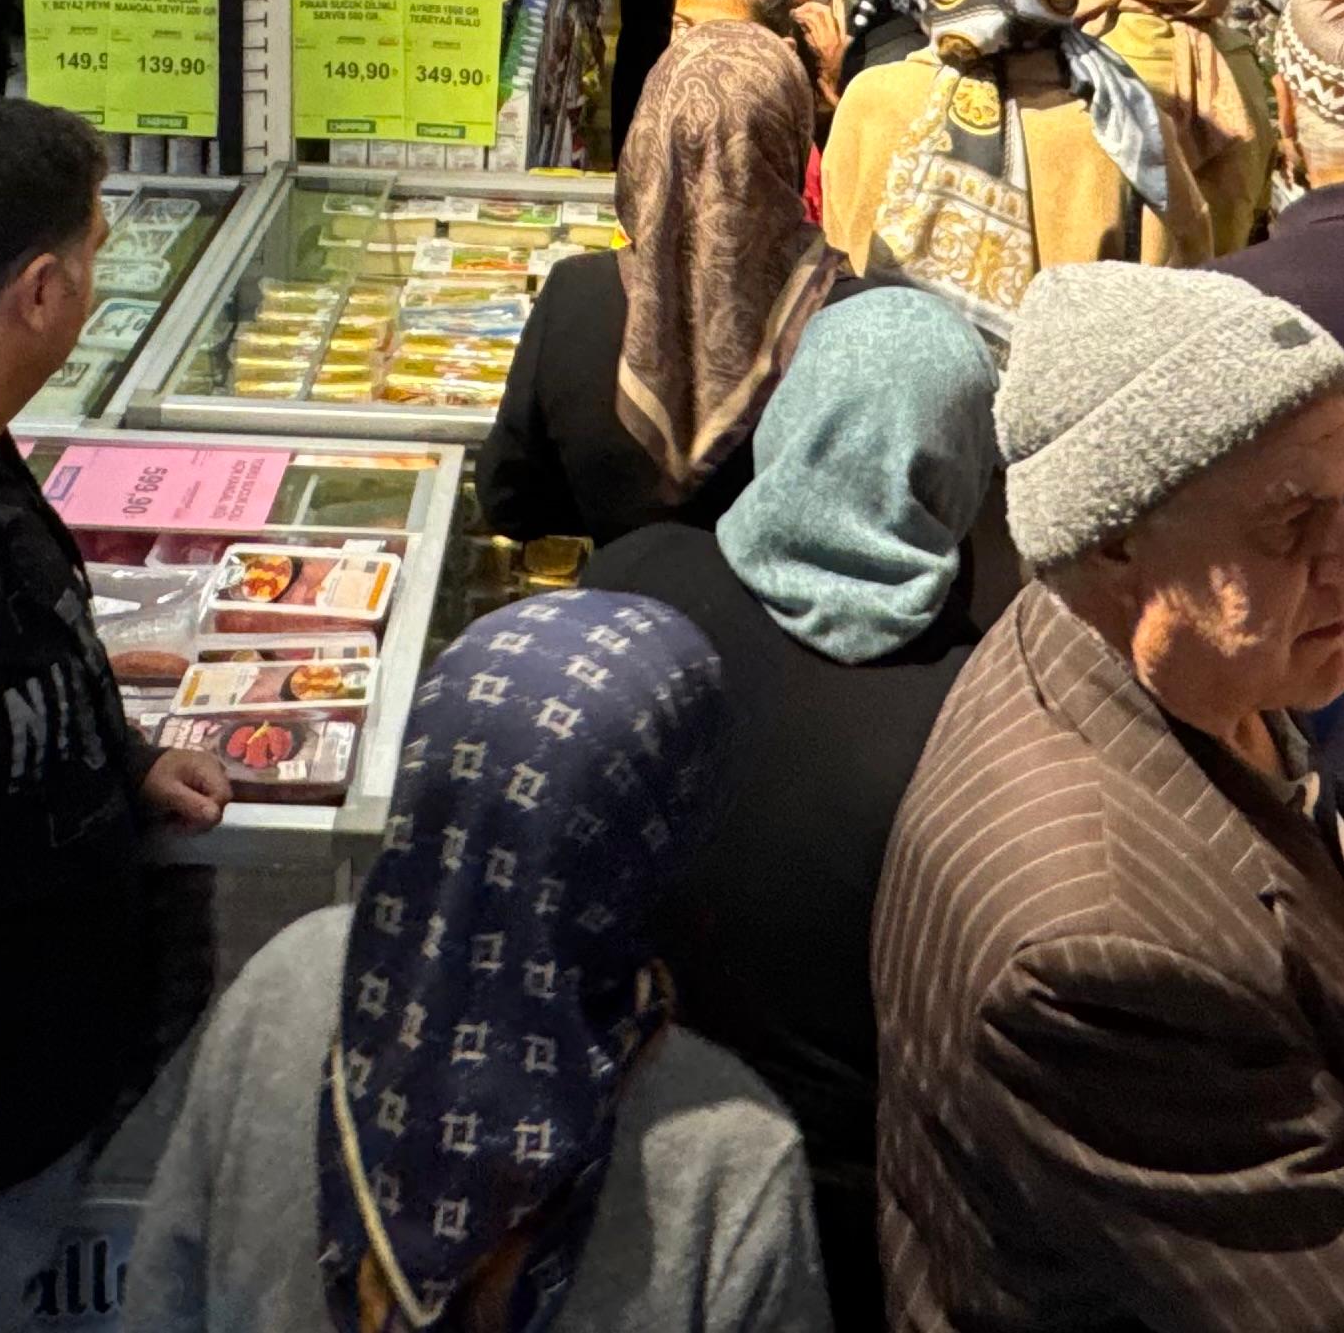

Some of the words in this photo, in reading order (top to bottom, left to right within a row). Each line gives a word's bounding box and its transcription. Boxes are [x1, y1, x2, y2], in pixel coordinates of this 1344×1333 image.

[85, 1, 110, 11] PEYN
[56, 51, 109, 73] 149,9
[137, 54, 205, 76] 139,90
[324, 60, 391, 82] 149,90
[415, 64, 484, 87] 349,90
